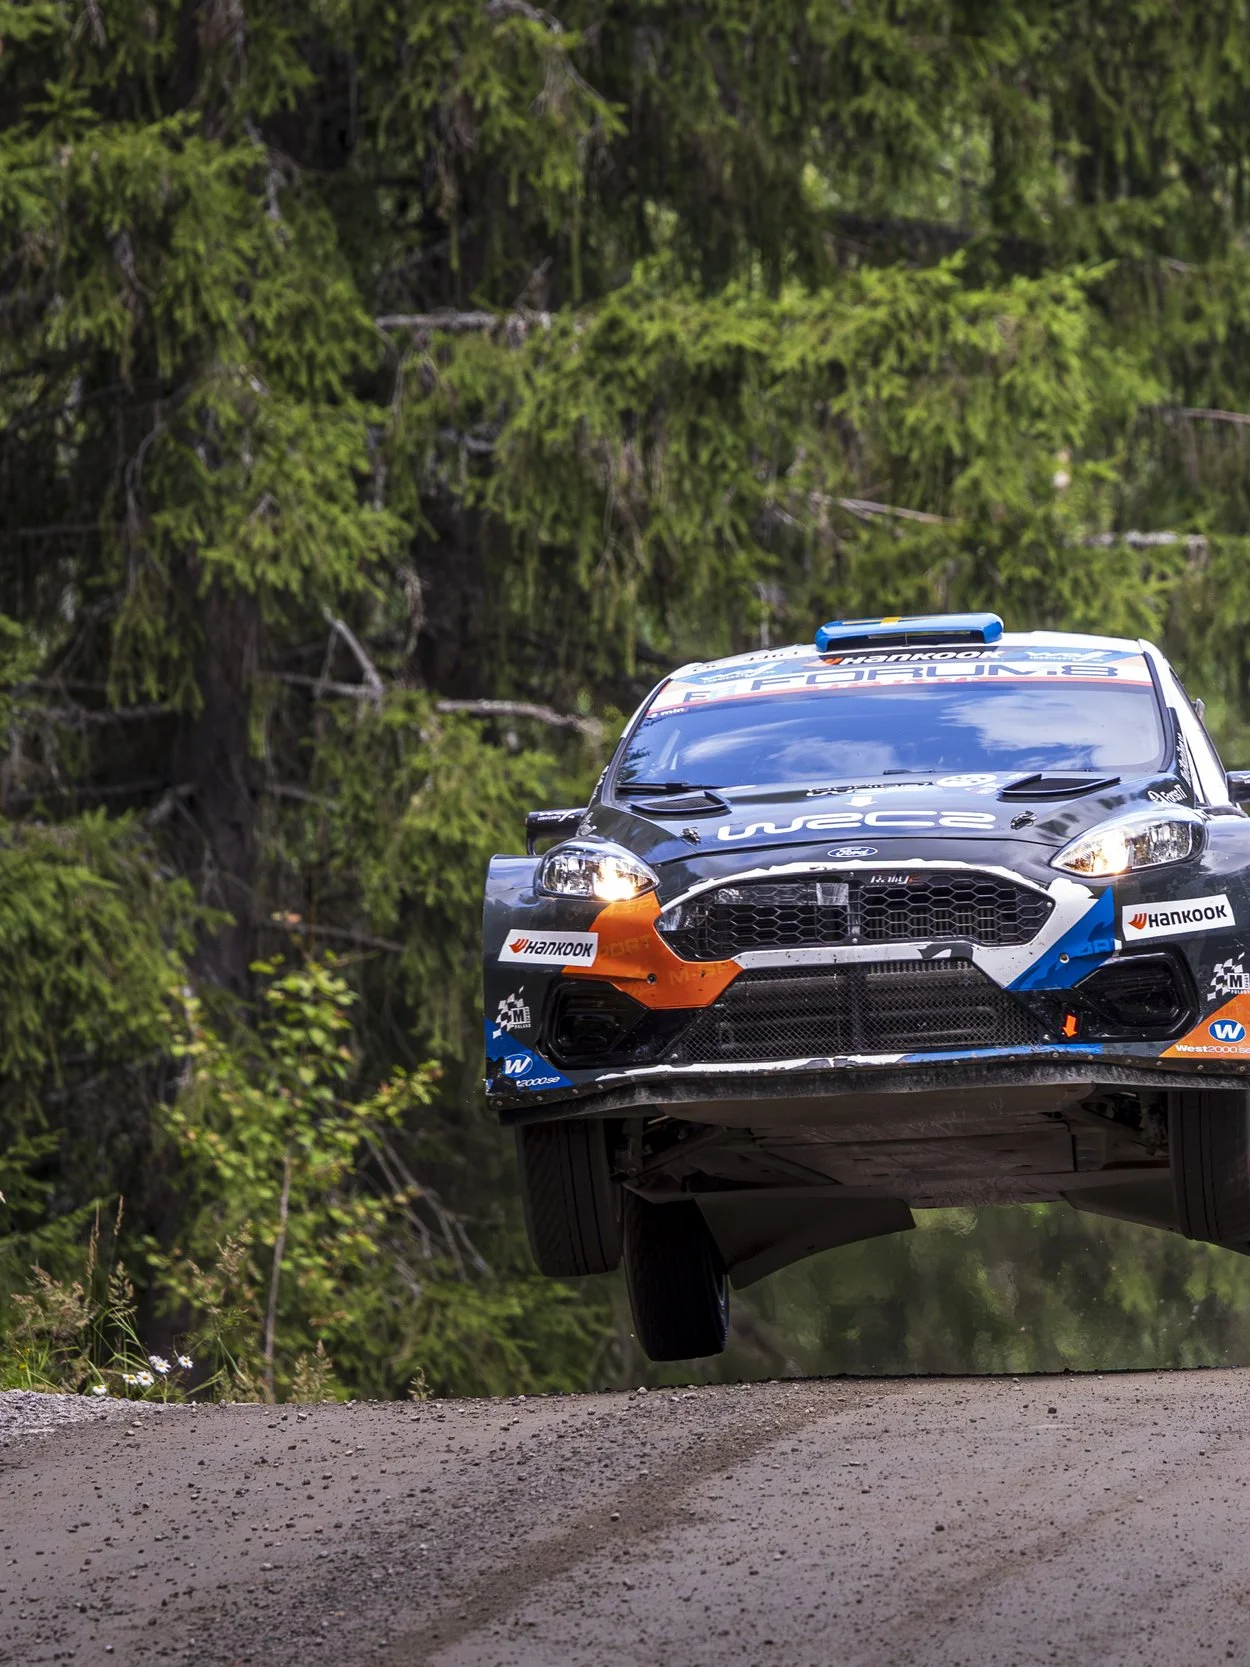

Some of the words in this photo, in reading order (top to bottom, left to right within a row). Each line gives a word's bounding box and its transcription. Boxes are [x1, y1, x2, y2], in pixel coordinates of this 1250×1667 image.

[836, 848, 870, 857] Ford
[1214, 1024, 1243, 1039] W
[505, 1059, 530, 1074] W
